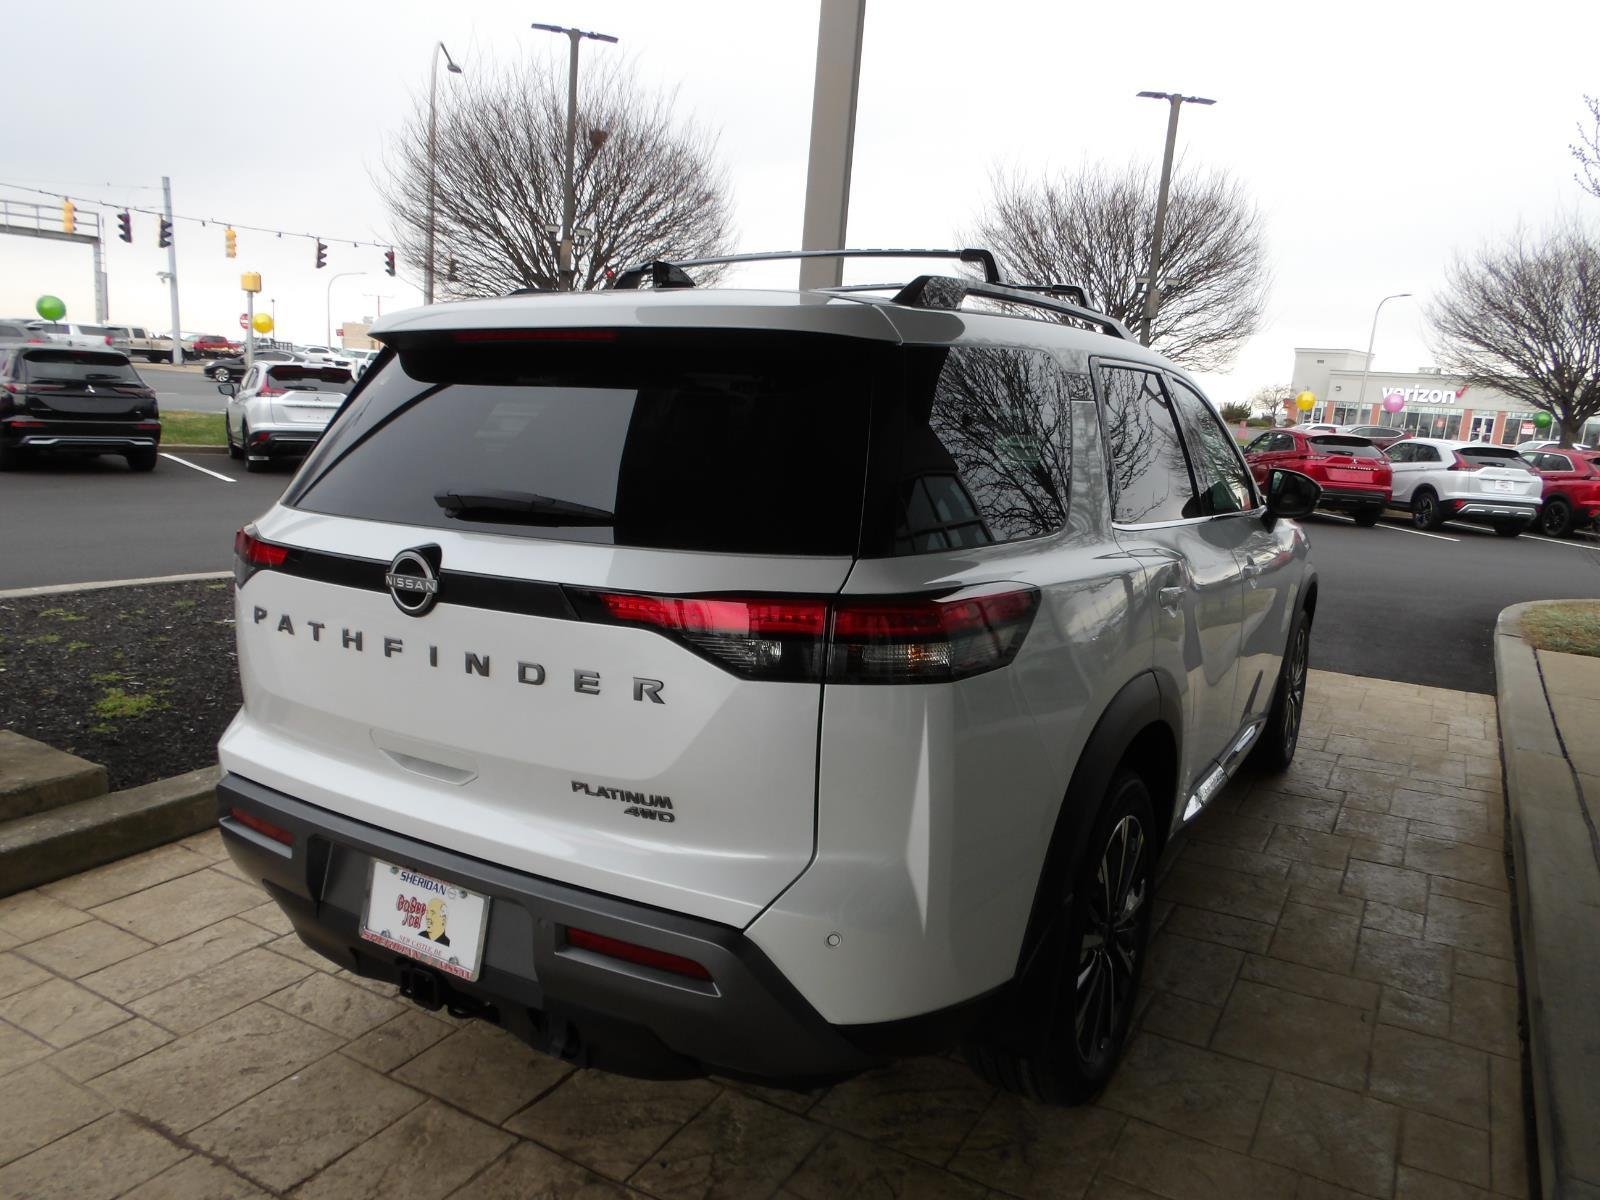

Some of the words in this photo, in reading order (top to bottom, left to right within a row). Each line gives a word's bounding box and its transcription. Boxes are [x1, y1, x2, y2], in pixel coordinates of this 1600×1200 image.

[385, 575, 436, 592] NISSAN
[253, 604, 666, 704] PATHFINDER
[570, 780, 673, 809] PLATINUM
[623, 806, 675, 823] 4WD
[400, 871, 447, 896] SHERIDAN
